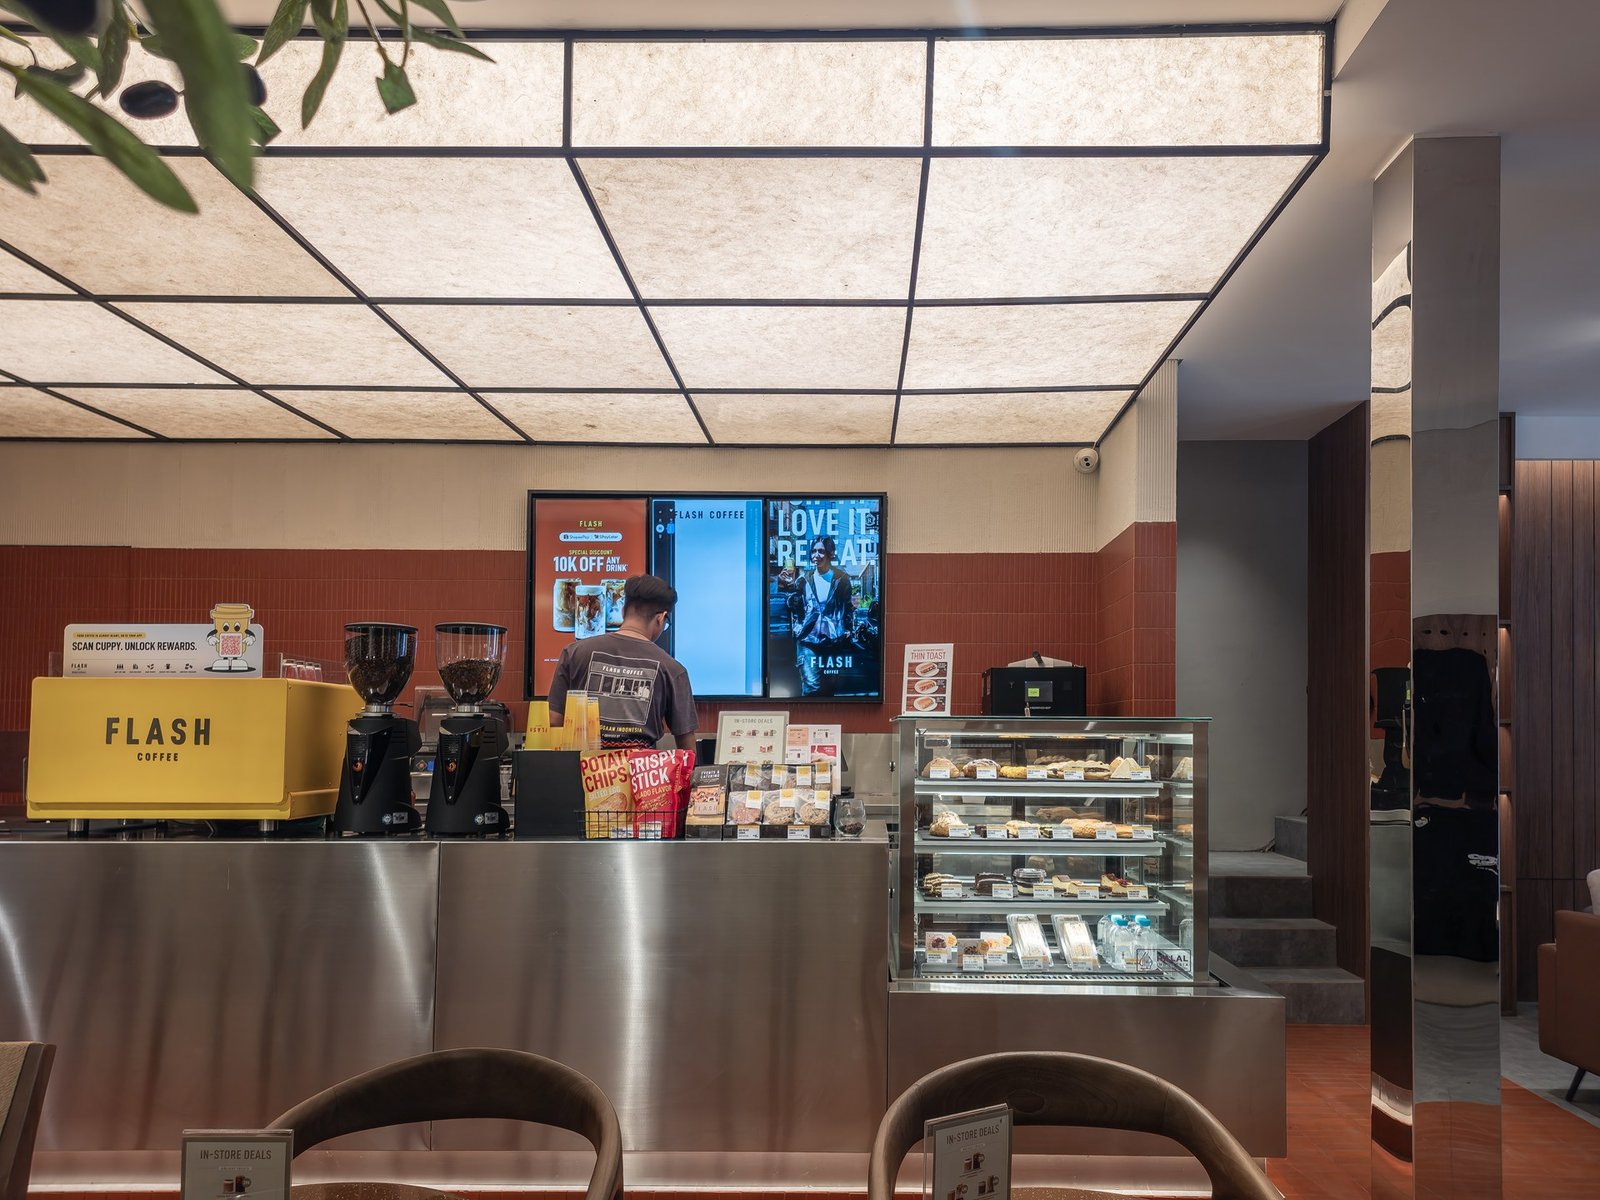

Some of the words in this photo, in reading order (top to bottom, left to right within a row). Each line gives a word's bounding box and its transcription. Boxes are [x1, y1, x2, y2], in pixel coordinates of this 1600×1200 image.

[709, 510, 744, 519] COFFEE
[778, 508, 840, 536] LOVE
[848, 508, 875, 535] IT.
[777, 539, 876, 567] REAT.
[553, 556, 577, 572] 10K
[579, 556, 604, 572] OFF
[606, 556, 621, 564] ANY
[72, 641, 94, 651] SCAN
[95, 641, 123, 651] CUPPY.
[124, 641, 156, 651] UNLOCK
[157, 641, 198, 651] REWARDS.
[810, 656, 853, 668] FLASH
[911, 652, 925, 660] THIN
[926, 652, 946, 660] TOAST
[602, 665, 621, 674] FLASH
[622, 668, 644, 676] COFFEE
[105, 717, 211, 746] FLASH
[137, 752, 179, 762] COFFEE
[629, 749, 676, 776] CRISPY
[584, 766, 627, 792] CHIPS
[631, 766, 671, 793] STICK
[946, 1129, 977, 1145] IN-STORE
[979, 1125, 1000, 1137] DEALS
[200, 1149, 241, 1160] IN-STORE
[243, 1149, 272, 1160] DEALS
